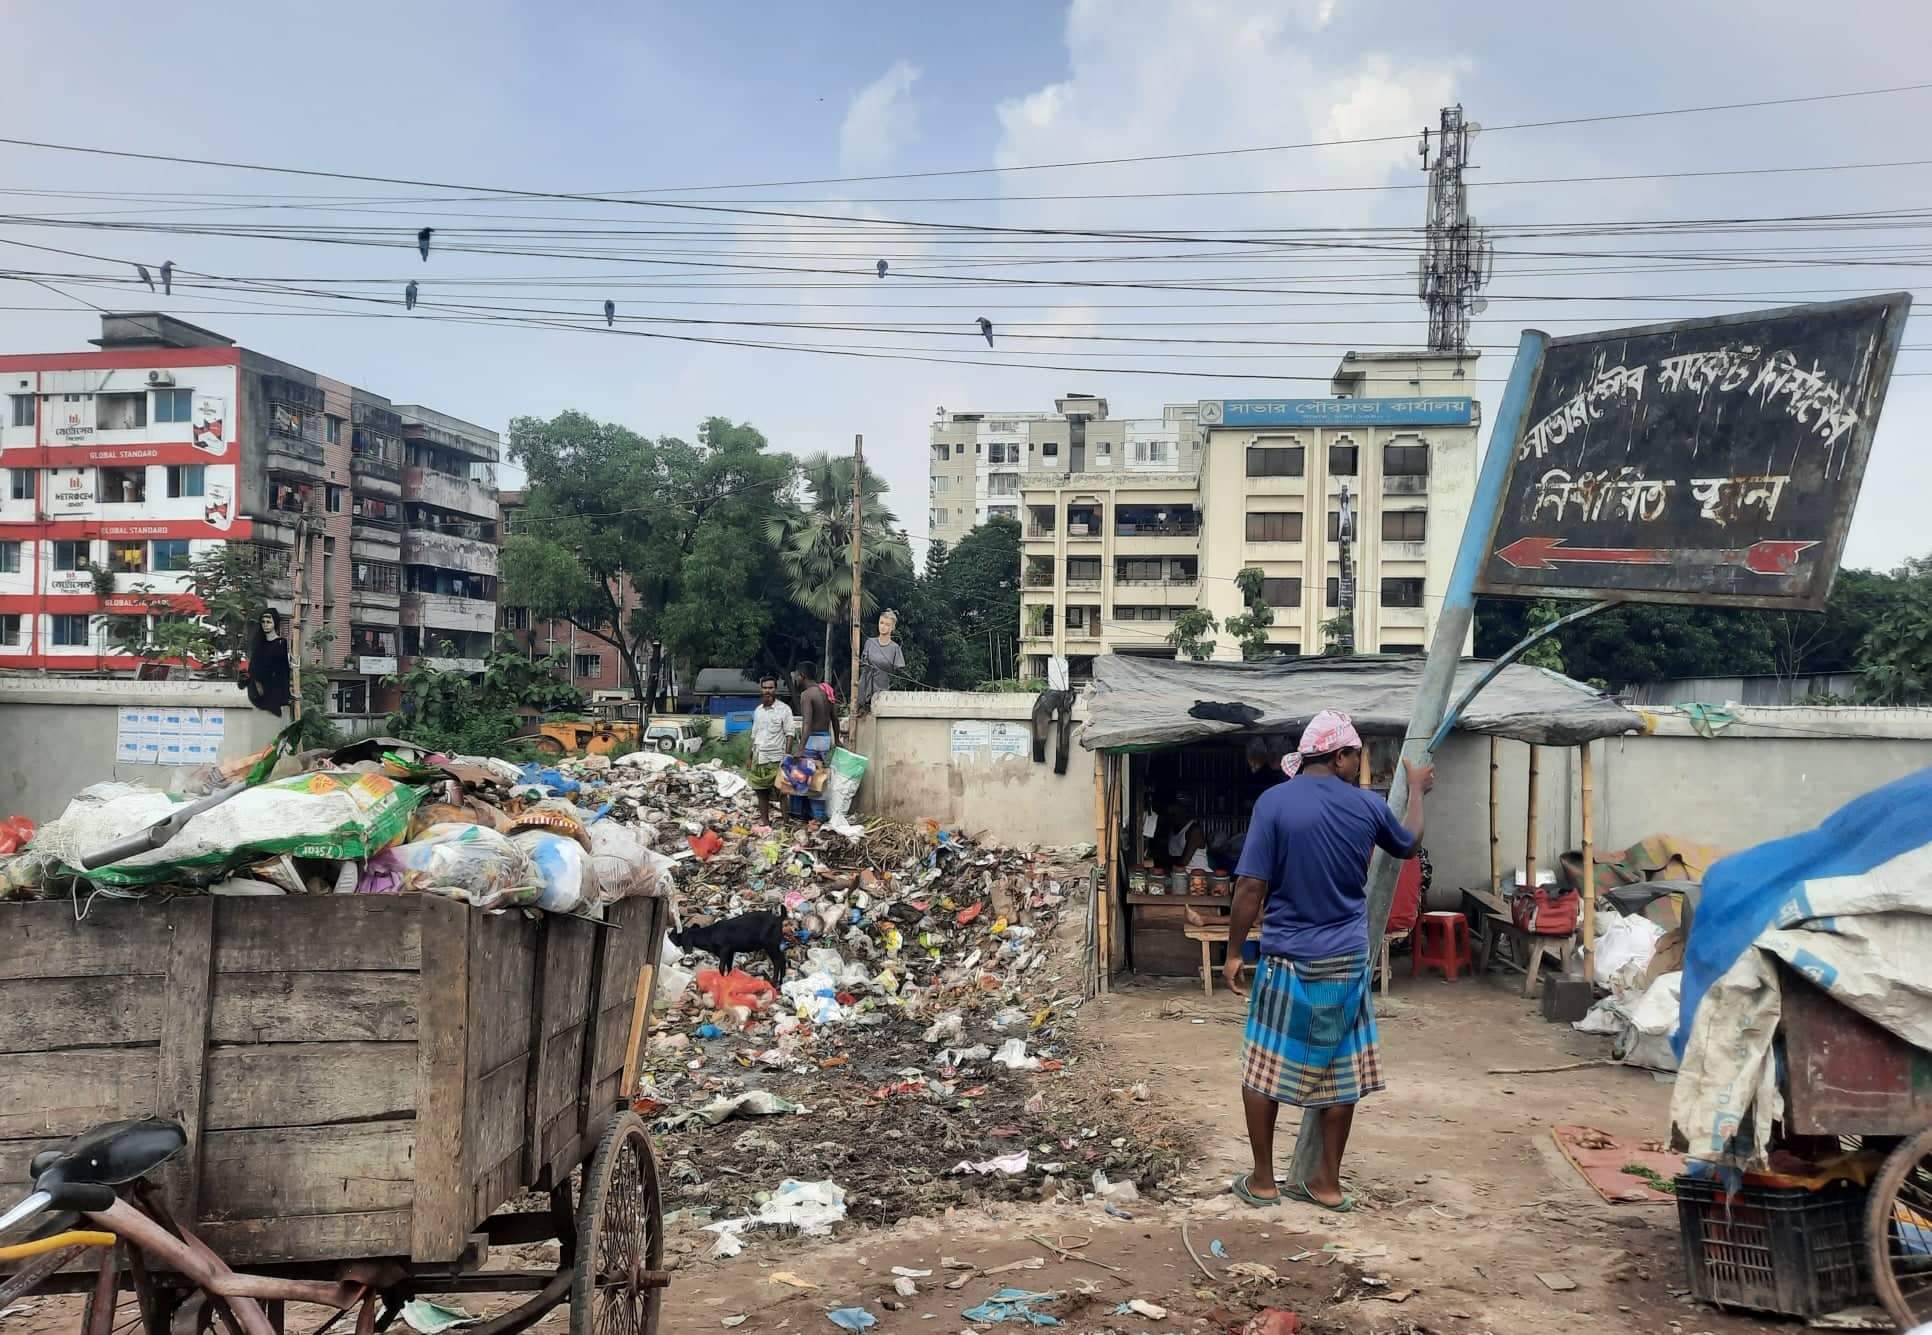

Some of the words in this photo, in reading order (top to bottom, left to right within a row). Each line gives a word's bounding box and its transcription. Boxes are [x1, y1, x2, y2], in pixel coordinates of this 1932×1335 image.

[1228, 402, 1286, 414] সাভার
[1295, 399, 1380, 415] পৌরসভা
[1390, 398, 1465, 413] কার্যালয়
[1519, 393, 1589, 461] সাভার
[90, 451, 117, 459] GLOBAL
[119, 449, 157, 458] STANDARD
[101, 527, 129, 535] GLOBAL
[130, 526, 168, 535] STANDARD
[104, 599, 133, 607] GLOBAL
